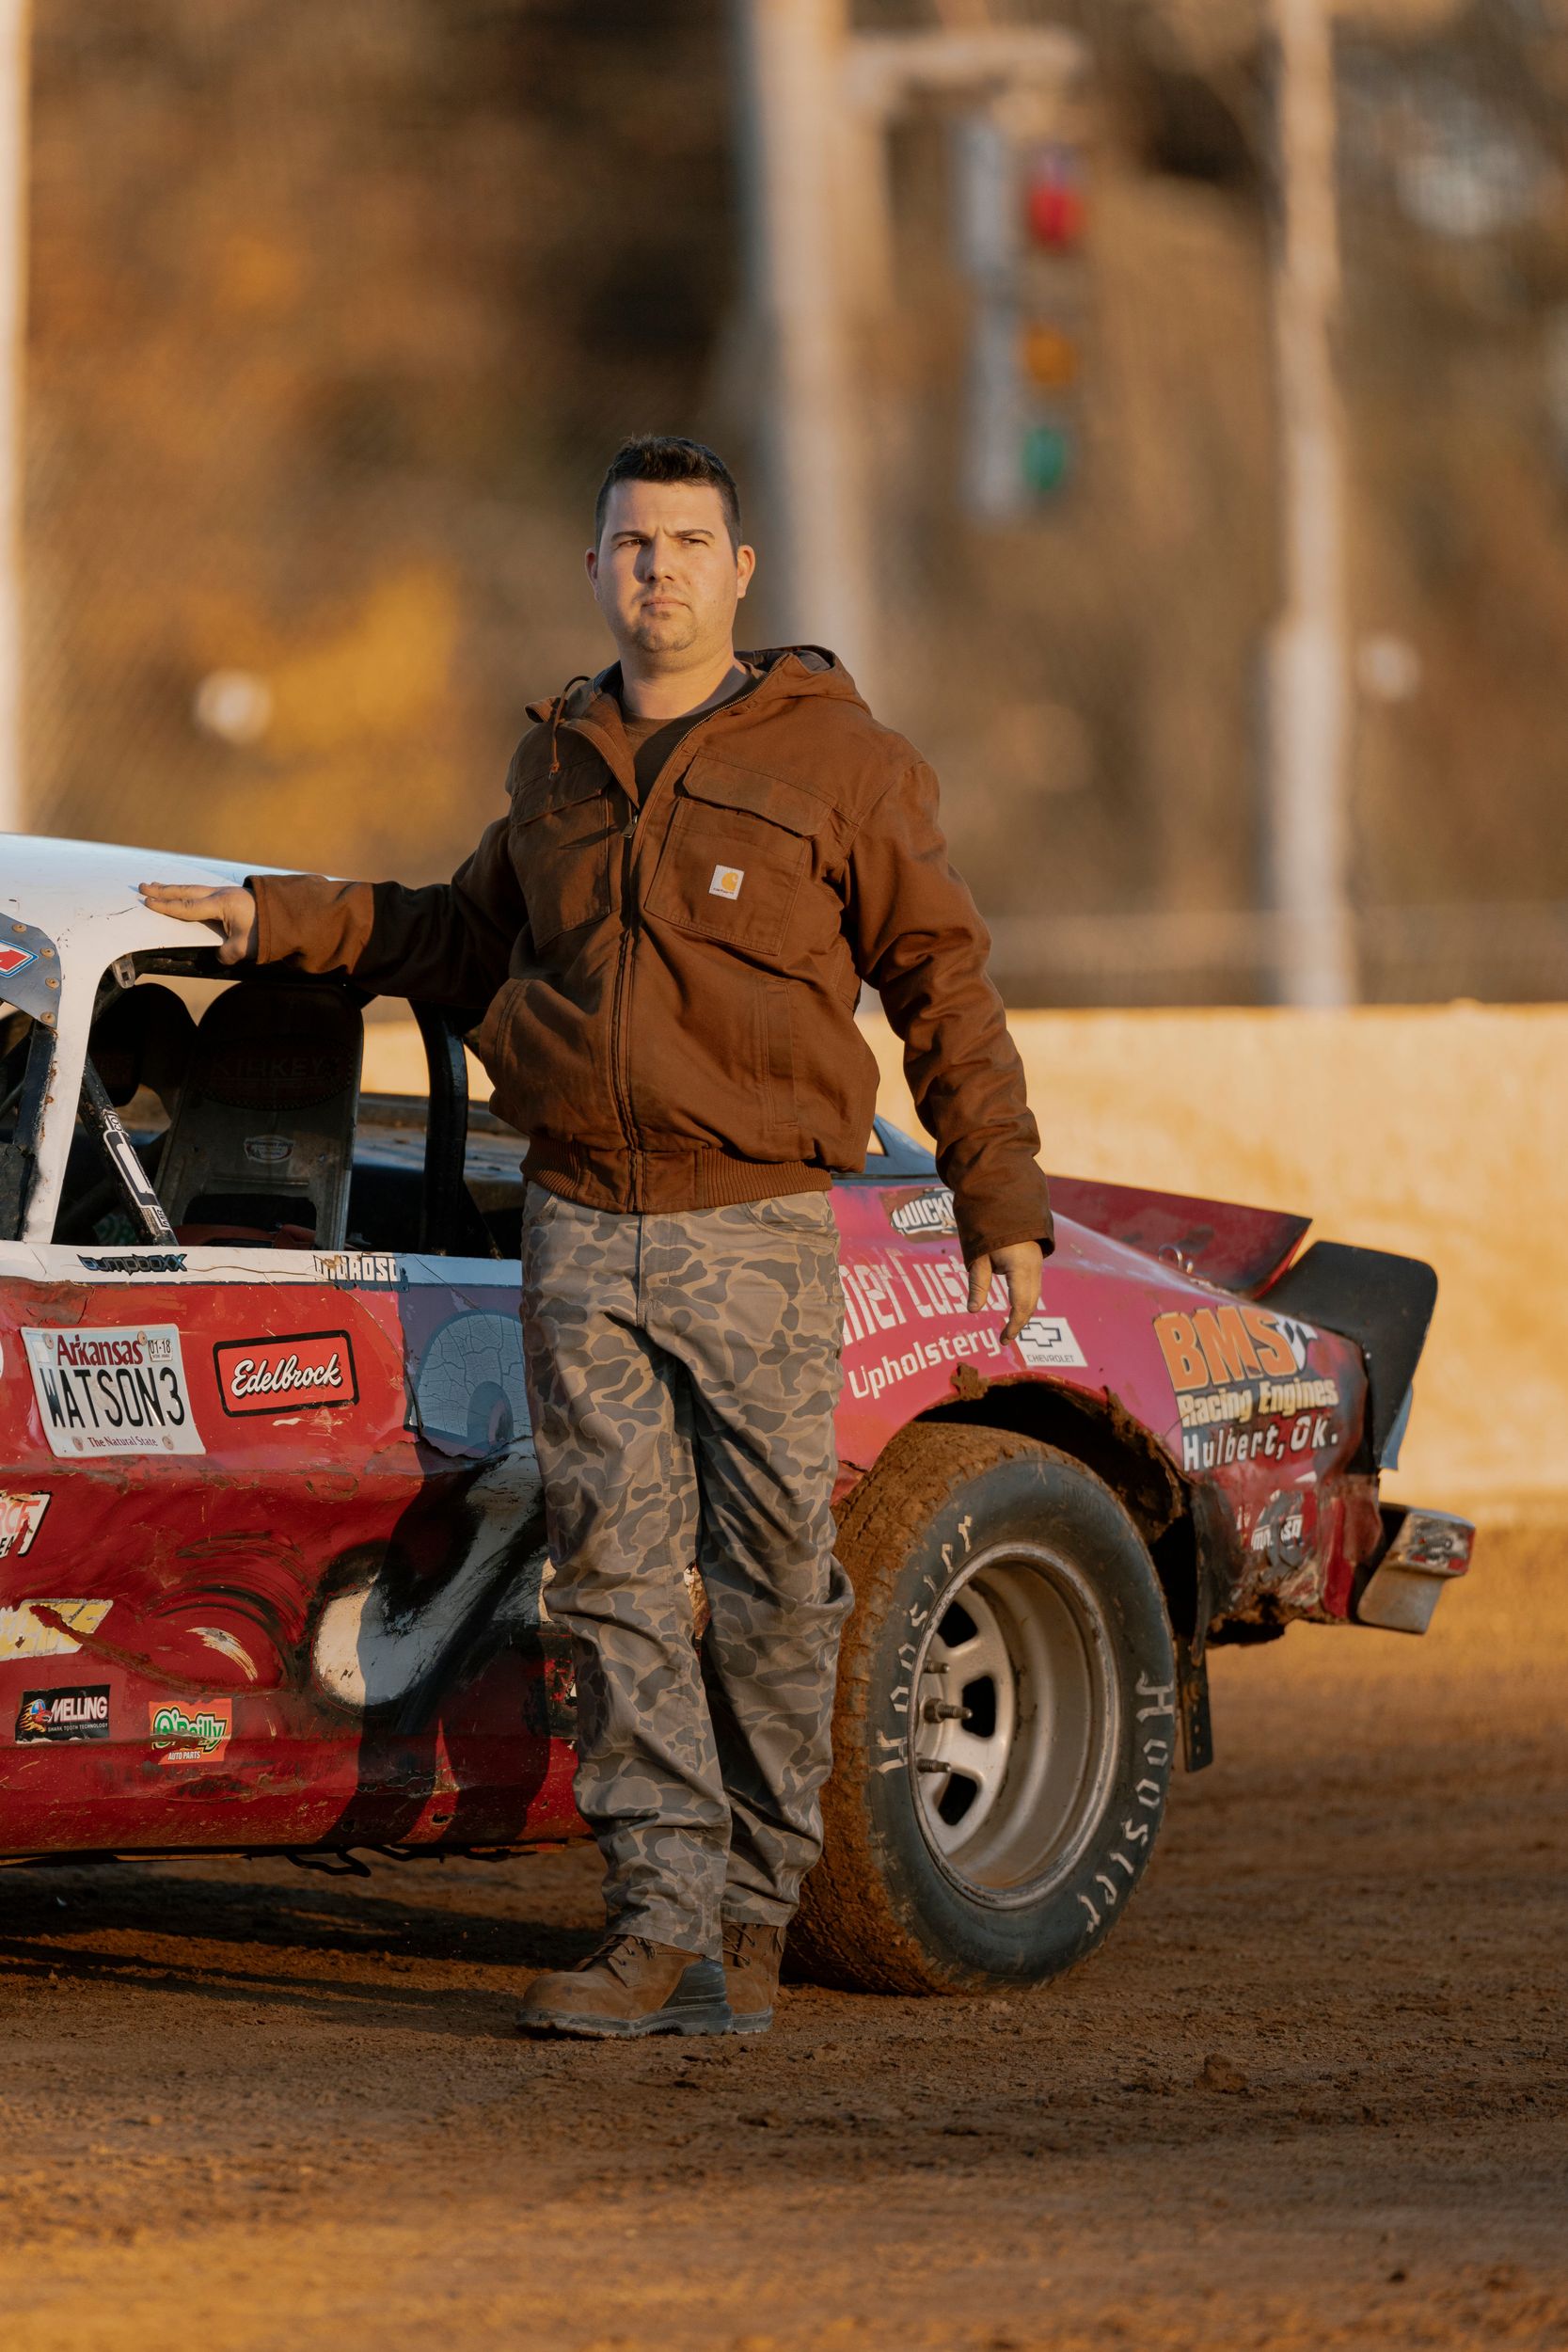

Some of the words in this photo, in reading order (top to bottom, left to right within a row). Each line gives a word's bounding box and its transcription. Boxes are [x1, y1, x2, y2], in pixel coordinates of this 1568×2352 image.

[57, 1333, 144, 1366] Arkansas
[150, 1339, 171, 1355] 01-18
[848, 1327, 1001, 1400] Upholstery
[1027, 1354, 1076, 1364] CHEVROLET
[1153, 1305, 1297, 1392] BMS
[230, 1353, 343, 1398] Edelbrock
[40, 1366, 185, 1429] WATSON3
[1177, 1388, 1254, 1429] Racing
[1258, 1378, 1339, 1417] Engines
[87, 1436, 104, 1450] The
[104, 1435, 136, 1449] Natural
[137, 1435, 158, 1448] State
[47, 1696, 108, 1724] MELLING
[182, 1751, 201, 1760] PARTS
